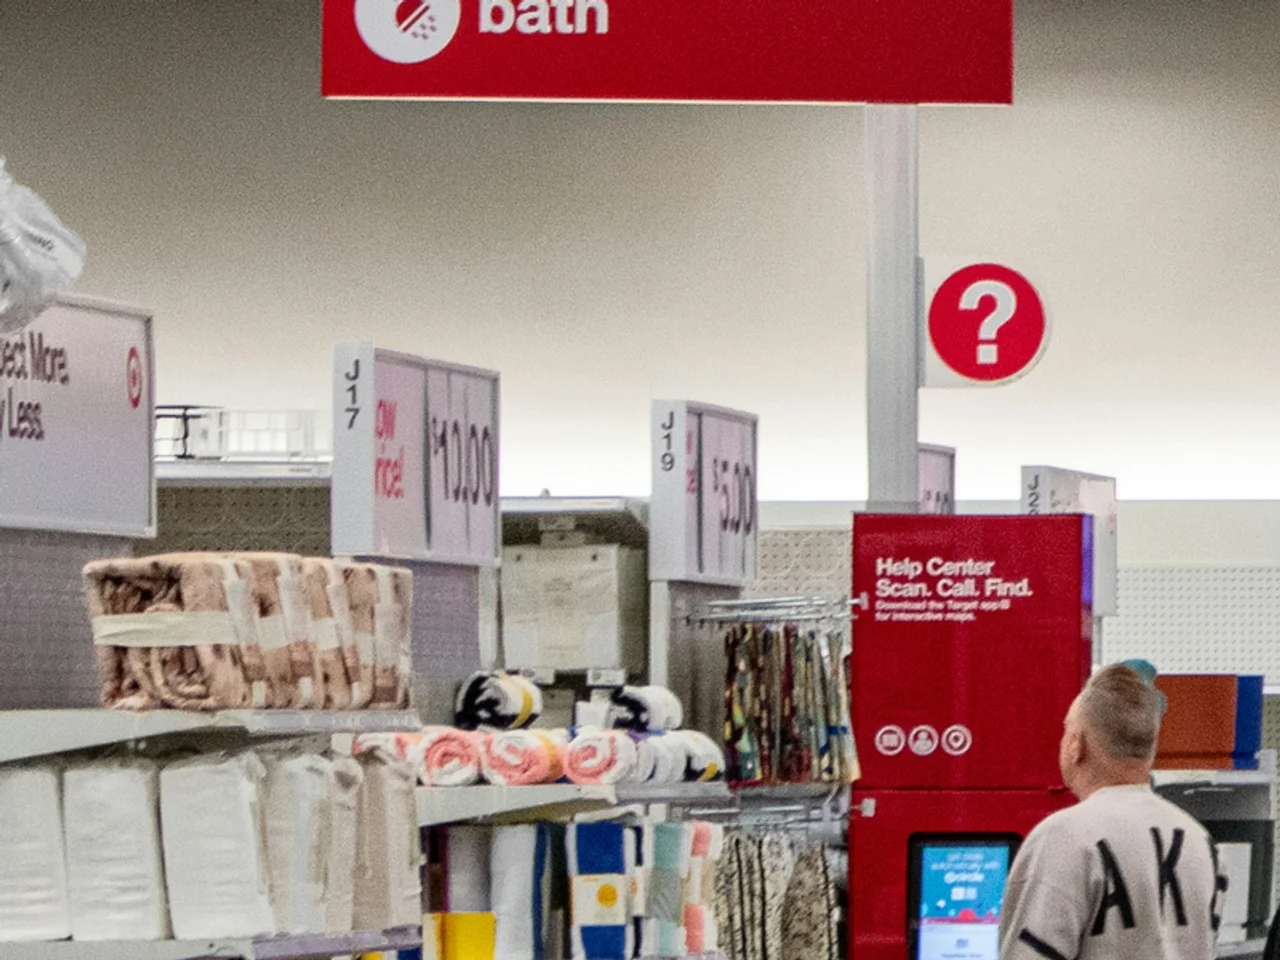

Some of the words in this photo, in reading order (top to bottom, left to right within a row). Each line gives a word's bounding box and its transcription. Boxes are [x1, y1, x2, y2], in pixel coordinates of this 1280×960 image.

[478, 0, 609, 34] bath
[0, 341, 27, 379] ect
[376, 399, 397, 440] ow
[875, 556, 923, 580] Help
[926, 556, 995, 577] Center
[875, 577, 932, 598] Scan.
[936, 577, 980, 598] Call.
[985, 577, 1033, 598] Find.
[874, 600, 926, 611] Download
[928, 600, 944, 611] the
[946, 600, 979, 613] Target
[874, 613, 890, 622] for
